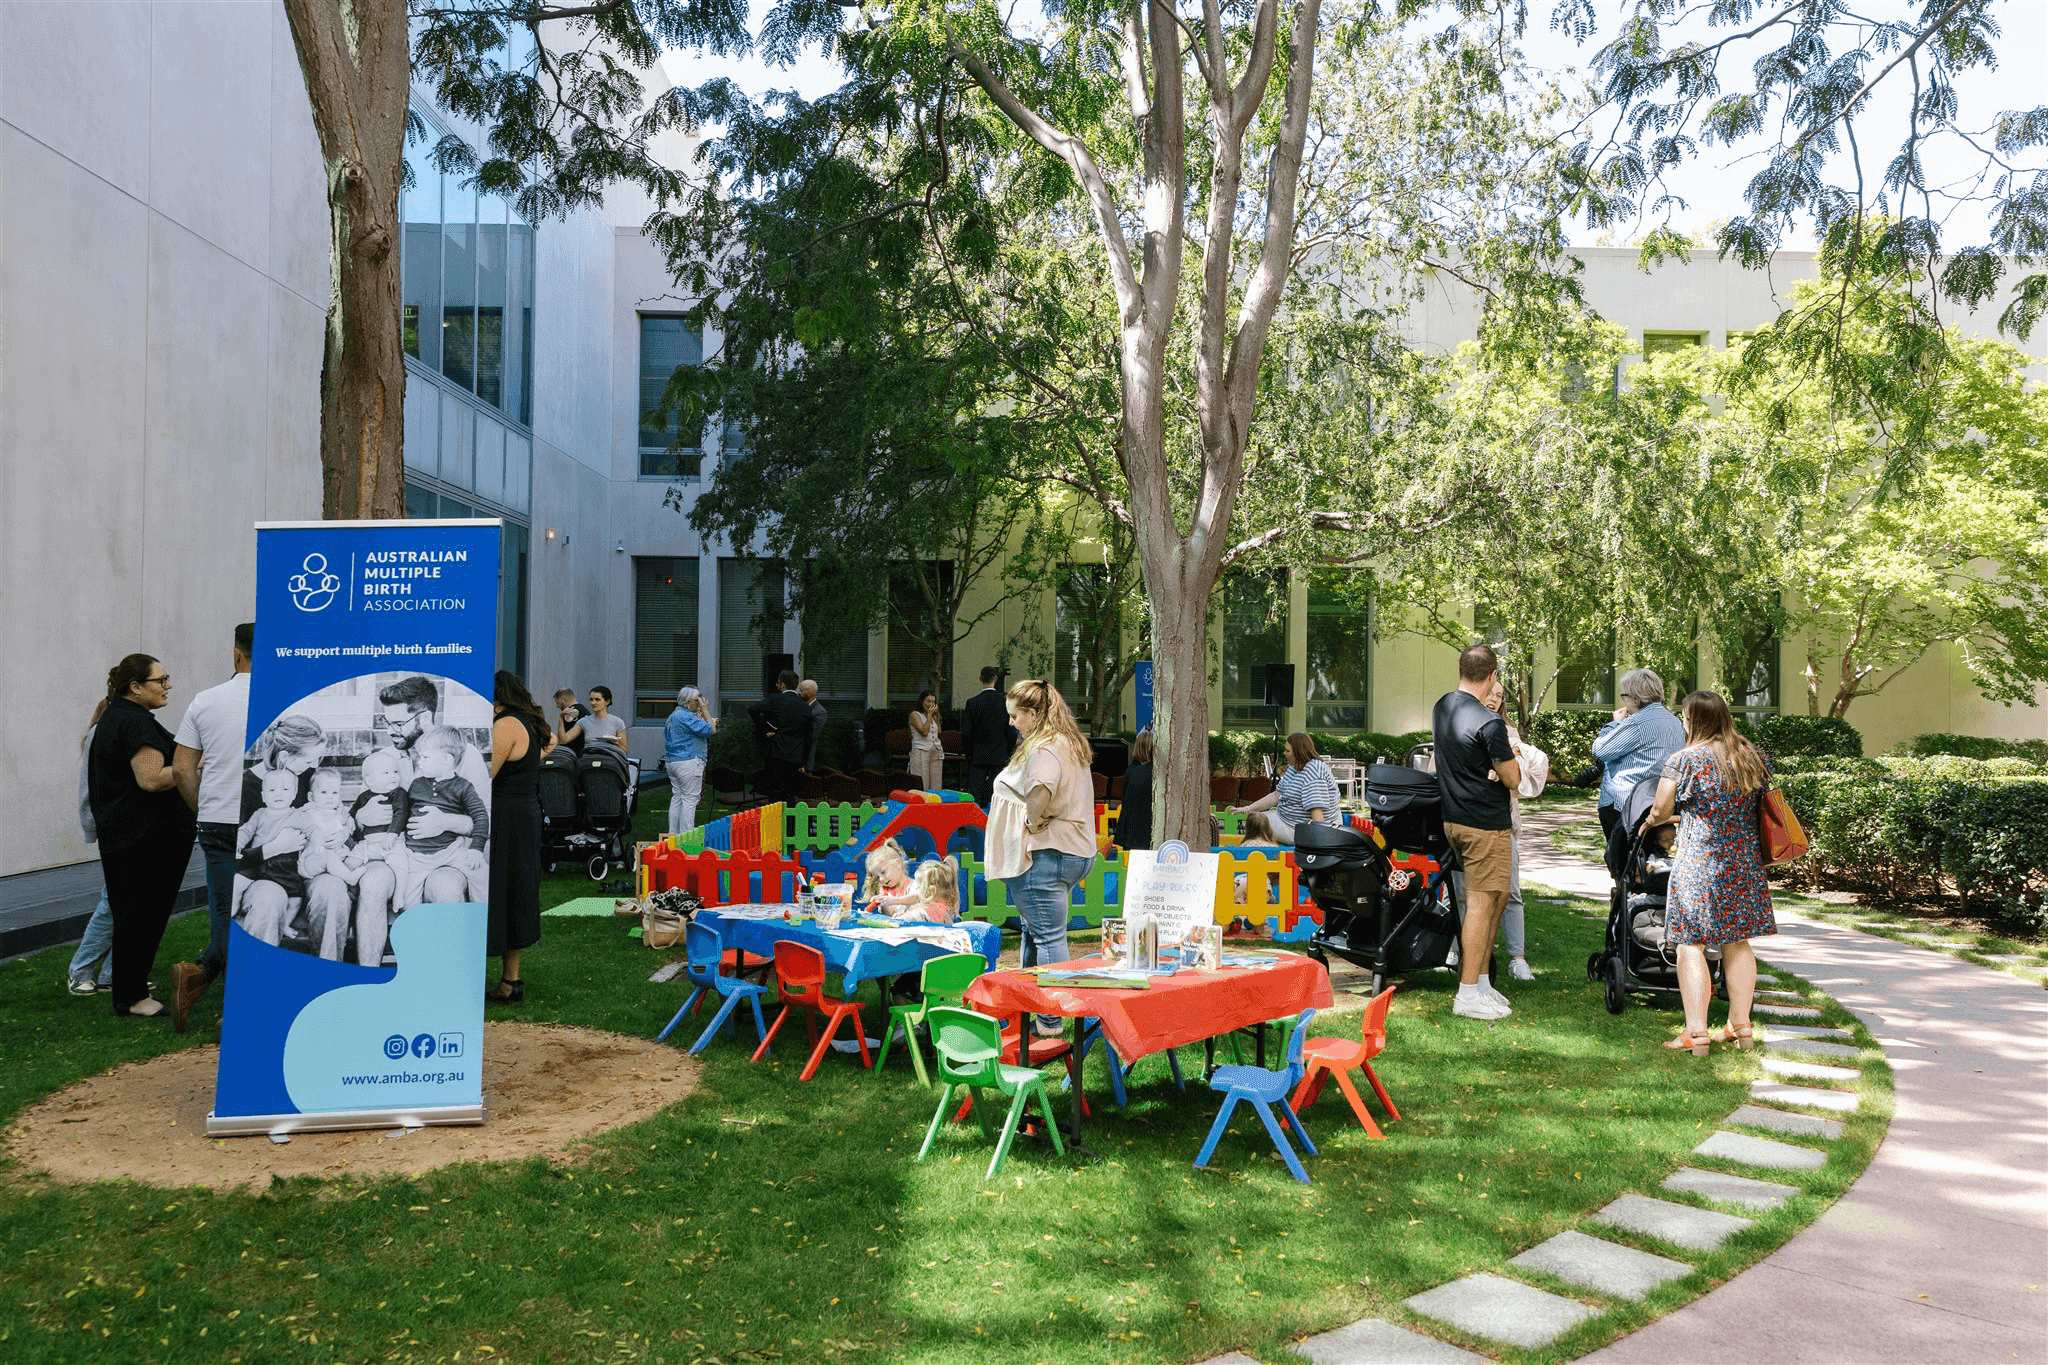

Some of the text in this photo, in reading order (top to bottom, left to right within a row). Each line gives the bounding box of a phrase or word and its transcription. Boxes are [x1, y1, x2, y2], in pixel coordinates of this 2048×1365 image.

[365, 550, 467, 563] AUSTRALIAN
[364, 567, 441, 579] MULTIPLE
[363, 583, 412, 595] BIRTH
[363, 598, 466, 612] ASSOCIATION
[275, 643, 472, 658] We support multiple birth families
[1143, 881, 1198, 893] PLAY RULES
[1144, 895, 1165, 903] SHOES
[1158, 920, 1175, 928] PAINT
[341, 1071, 465, 1085] www.amba.org.au
